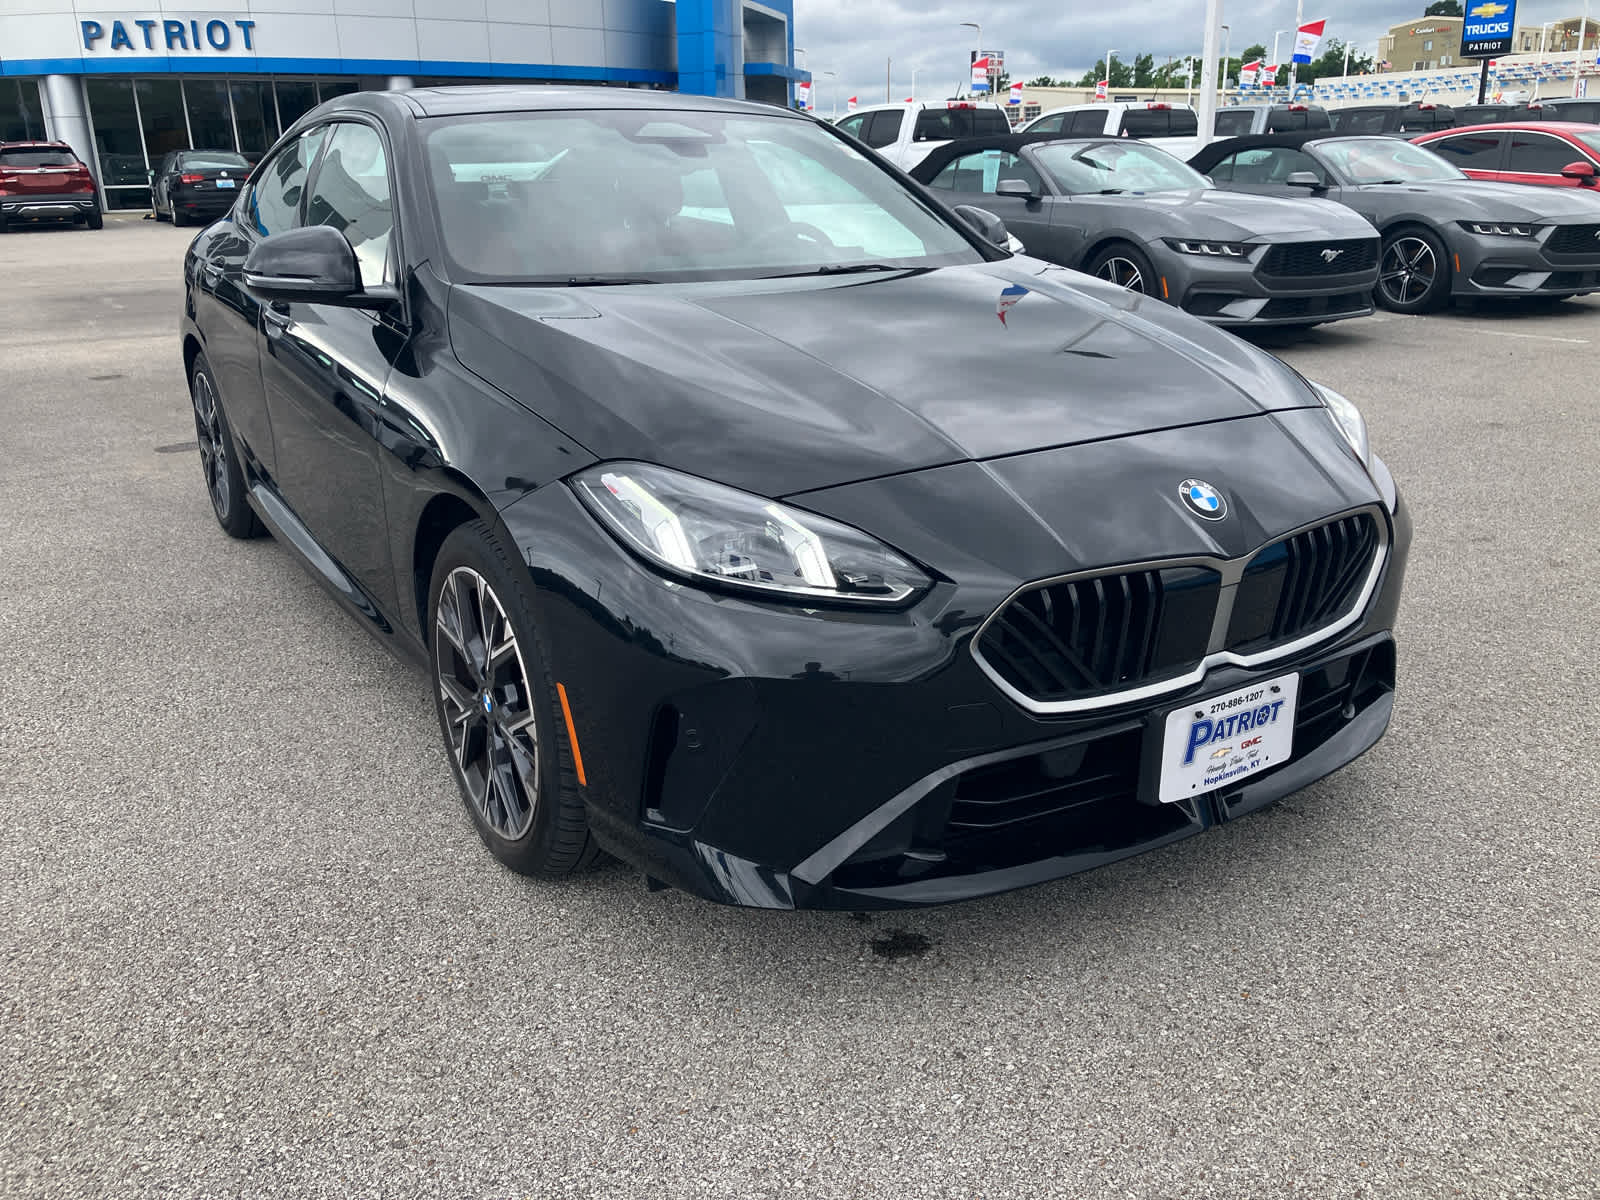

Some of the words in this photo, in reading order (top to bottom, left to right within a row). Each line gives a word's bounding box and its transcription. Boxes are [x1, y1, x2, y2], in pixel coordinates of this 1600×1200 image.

[80, 20, 256, 51] PATRIOT
[1465, 22, 1509, 36] TRUCKS
[1469, 41, 1502, 51] PATRIOT
[1210, 689, 1264, 714] 270-886-1207
[1183, 700, 1284, 766] PATRIOT
[1241, 736, 1262, 749] GMC
[1203, 765, 1249, 786] Hopkinsville,
[1250, 758, 1261, 769] KY
